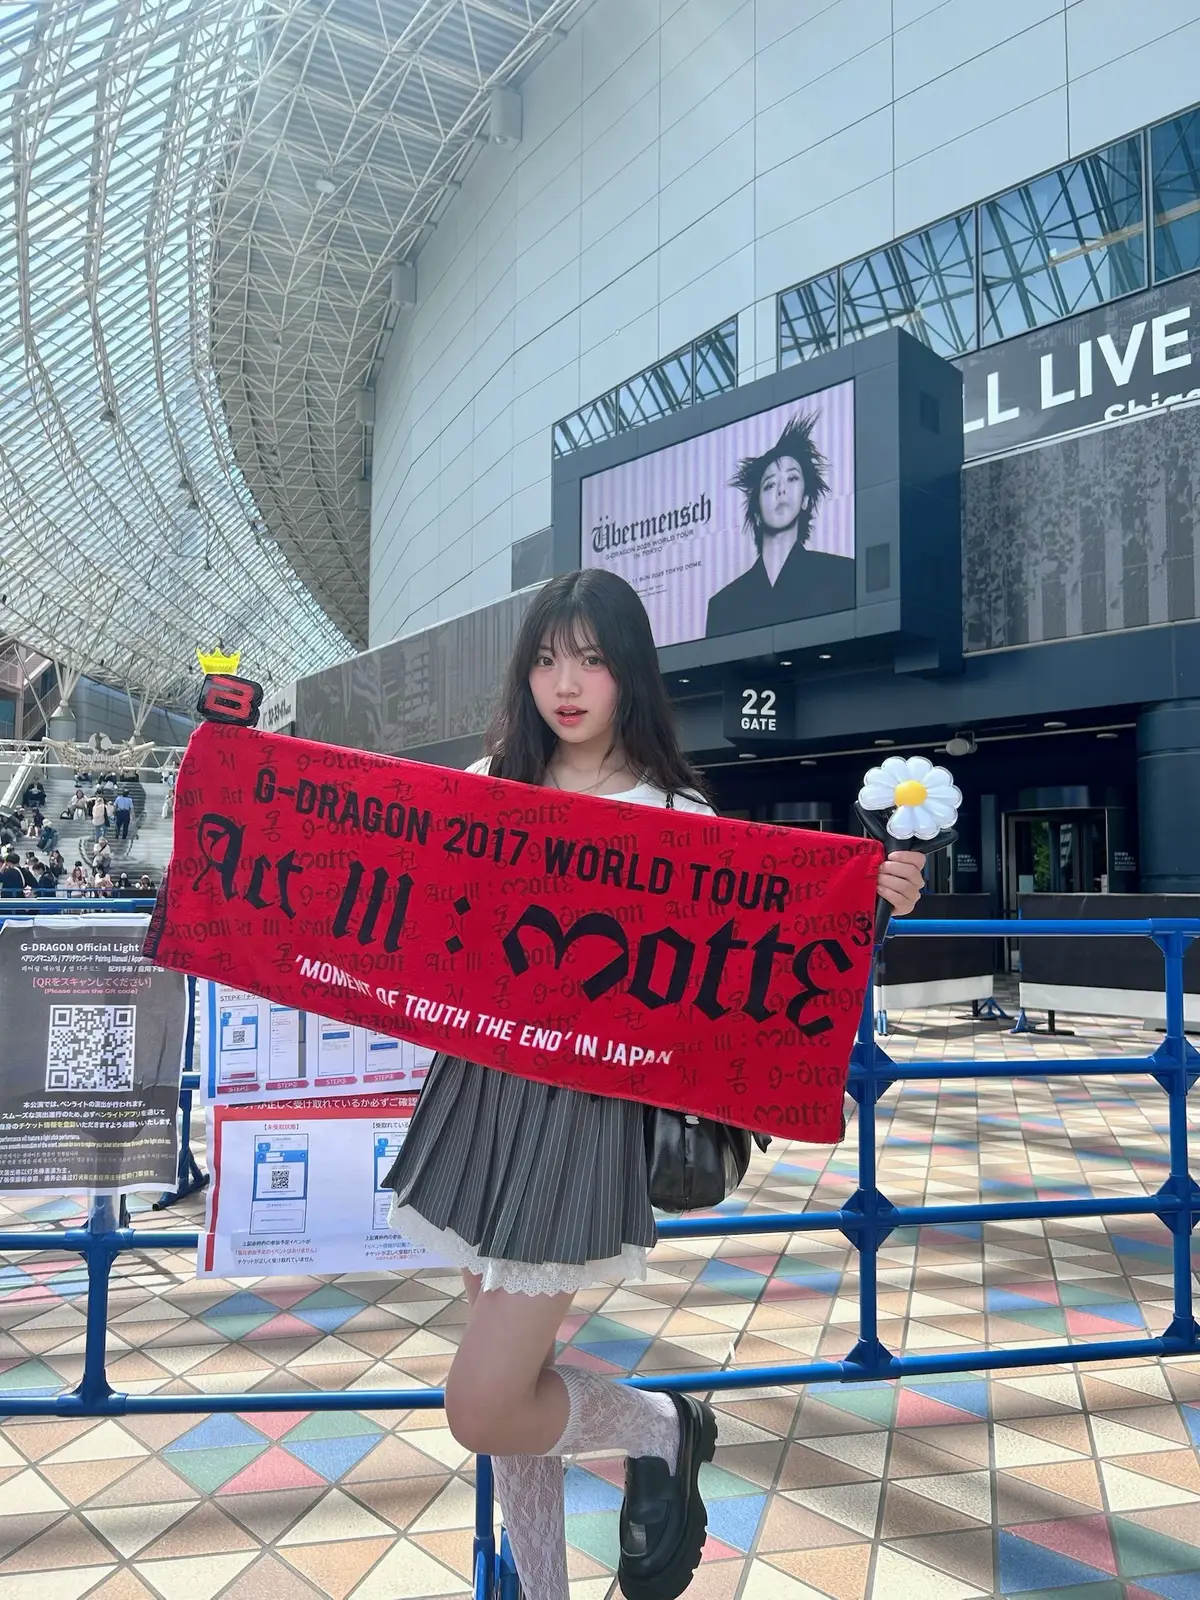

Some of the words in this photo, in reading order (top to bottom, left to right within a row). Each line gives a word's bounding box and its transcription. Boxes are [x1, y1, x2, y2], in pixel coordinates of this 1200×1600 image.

[1041, 306, 1192, 410] LIVE
[591, 492, 711, 553] Übermensch
[605, 546, 635, 560] G-DRAGON
[636, 542, 651, 552] 2025
[652, 534, 675, 548] WORLD
[677, 529, 694, 541] TOUR
[642, 546, 663, 557] TOKYO
[685, 560, 702, 571] DOME
[742, 689, 776, 715] 22
[741, 717, 776, 731] GATE
[256, 768, 432, 846] G-DRAGON
[443, 817, 529, 866] 2017
[545, 836, 673, 895] WORLD
[690, 863, 790, 913] TOUR
[193, 814, 304, 920] Act
[20, 943, 74, 952] G-DRAGON
[76, 942, 111, 952] Official
[114, 942, 140, 954] Light
[376, 988, 399, 1009] OF
[405, 994, 471, 1029] TRUTH
[476, 1014, 516, 1041] THE
[575, 1033, 598, 1057] IN
[602, 1040, 673, 1066] JAPAN
